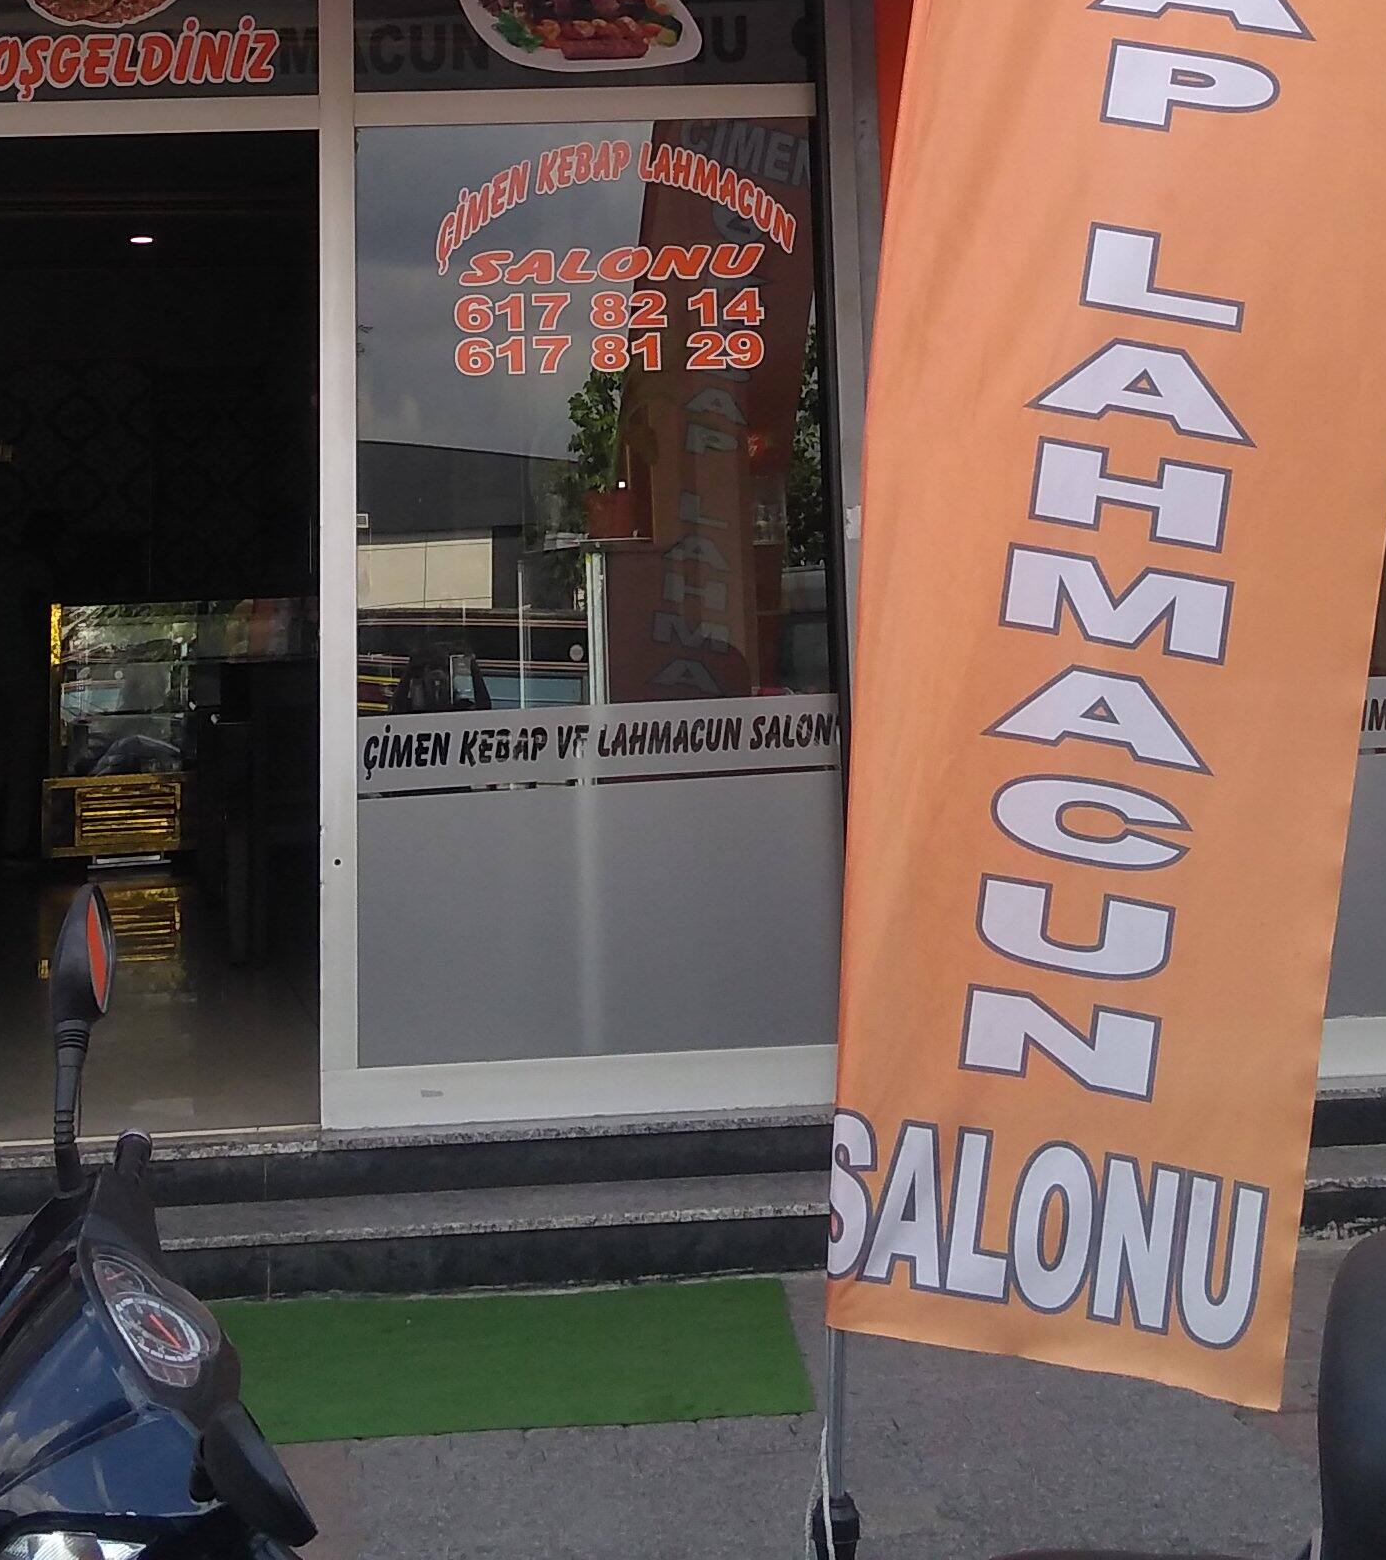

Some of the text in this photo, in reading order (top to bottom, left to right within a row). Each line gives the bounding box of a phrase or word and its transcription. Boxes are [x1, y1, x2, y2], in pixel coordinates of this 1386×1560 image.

[536, 141, 631, 195] KEBAP
[638, 142, 797, 254] LAHMACUN
[459, 243, 765, 286] SALONU
[454, 288, 764, 332] 617 82 14
[454, 330, 764, 376] 617 81 29
[958, 221, 1258, 1103] LAHMACUN
[362, 724, 451, 780] ÇİMEN
[460, 726, 547, 767] KEBAP
[556, 724, 589, 760] VE
[597, 716, 742, 757] LAHMACUN
